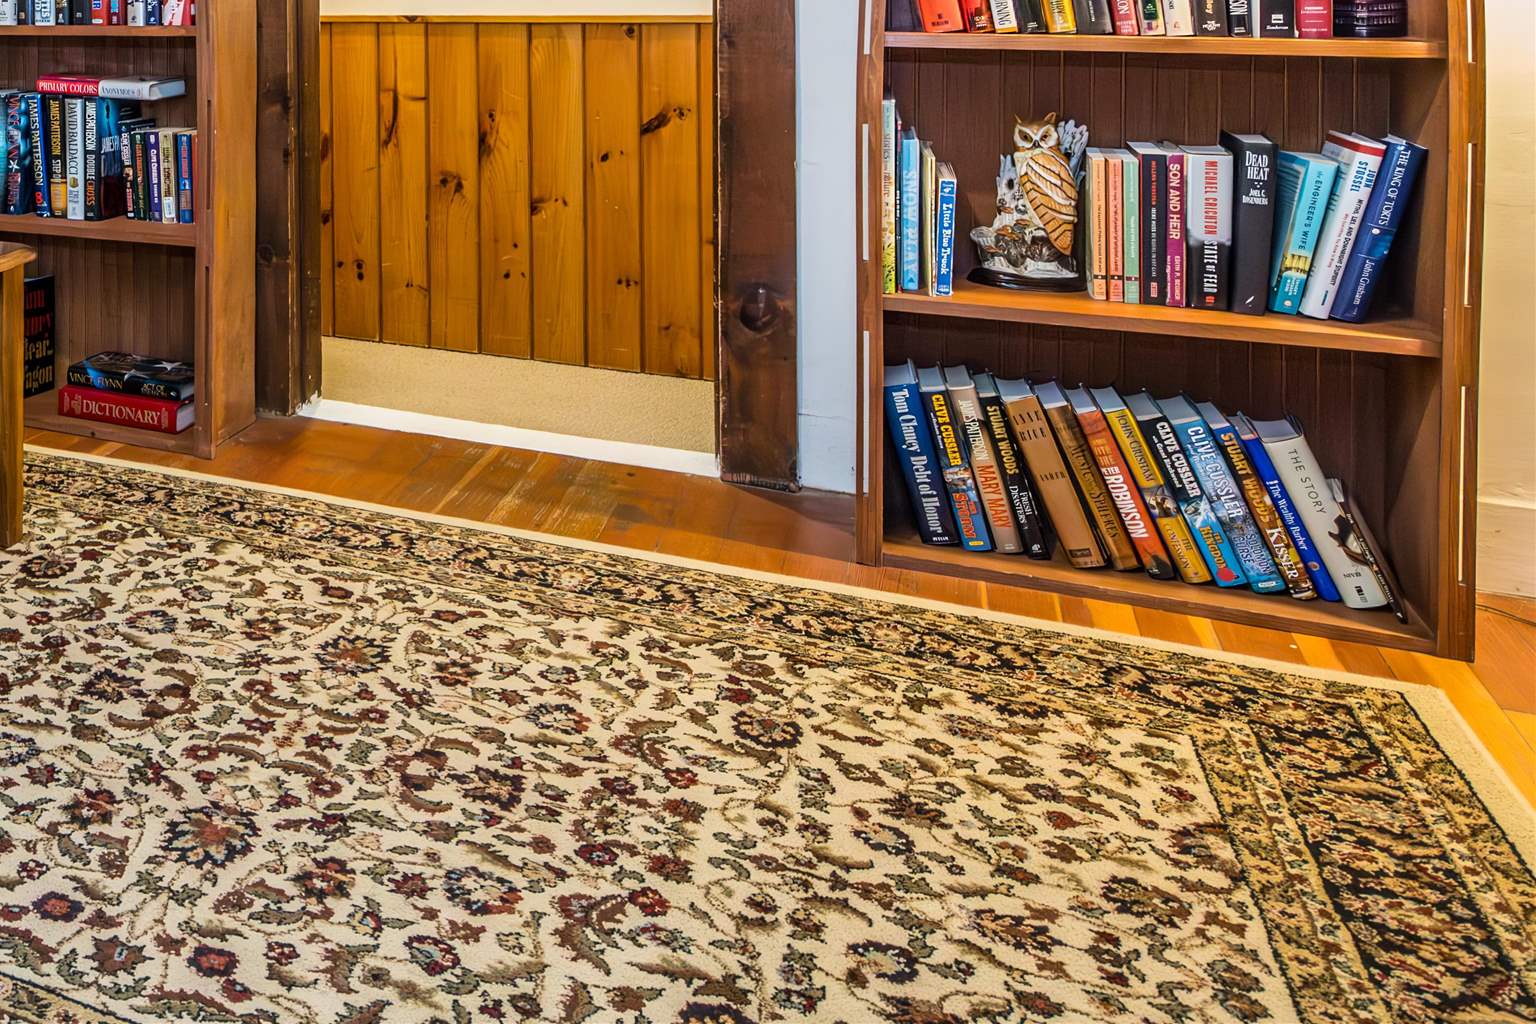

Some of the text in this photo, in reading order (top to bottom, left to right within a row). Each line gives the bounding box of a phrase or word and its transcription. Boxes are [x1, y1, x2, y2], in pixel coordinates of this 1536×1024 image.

[38, 82, 98, 94] PRIMARY COLORS
[86, 101, 95, 117] JAMES
[28, 99, 43, 185] JAMES PATTERSON
[50, 100, 61, 173] JAMES PATTERSON STEP
[68, 103, 78, 175] DAVID BALDACCI
[86, 117, 96, 150] PATTERSON
[1246, 151, 1268, 167] DEAD
[87, 155, 95, 179] DOUBLE
[1247, 167, 1269, 180] HEAT
[1350, 161, 1368, 192] STOSSEL
[1364, 169, 1376, 189] JOHN
[1378, 150, 1410, 226] THE KING OF TORTS
[1169, 164, 1180, 239] SON AND HEIR
[1204, 160, 1218, 235] MICHAEL CRICHTON
[1298, 180, 1322, 250] ENGINEER'S WIFE
[940, 203, 952, 274] Little Blue Truck
[1204, 241, 1217, 263] STATE
[1203, 274, 1217, 292] FEAR
[1353, 260, 1375, 304] John Grisham
[83, 400, 160, 425] DICTIONARY
[932, 394, 962, 466] CLIVE CUSSLER
[987, 406, 1019, 474] STUART WOODS
[892, 389, 944, 533] Tom Clancy Debt of Honor
[958, 400, 1011, 528] JAMES PATTERSON MARY MARY
[1115, 415, 1154, 482] JOHN GRISHAM
[1156, 422, 1201, 498] CLIVE CUSSLER
[1188, 426, 1243, 518] CLIVE CUSSLER
[1009, 486, 1027, 524] DISASTERS
[1020, 492, 1032, 515] FRESH
[1223, 432, 1272, 523] STUART WOODS
[1288, 449, 1326, 514] THE STORY
[953, 493, 976, 538] STORM
[1105, 475, 1148, 538] ROBINSON
[1272, 486, 1308, 551] The Wealthy Barber
[1163, 524, 1191, 569] CONFESSION
[1182, 539, 1193, 552] THE
[1234, 535, 1253, 564] CURSE
[1266, 528, 1299, 578] KISSER
